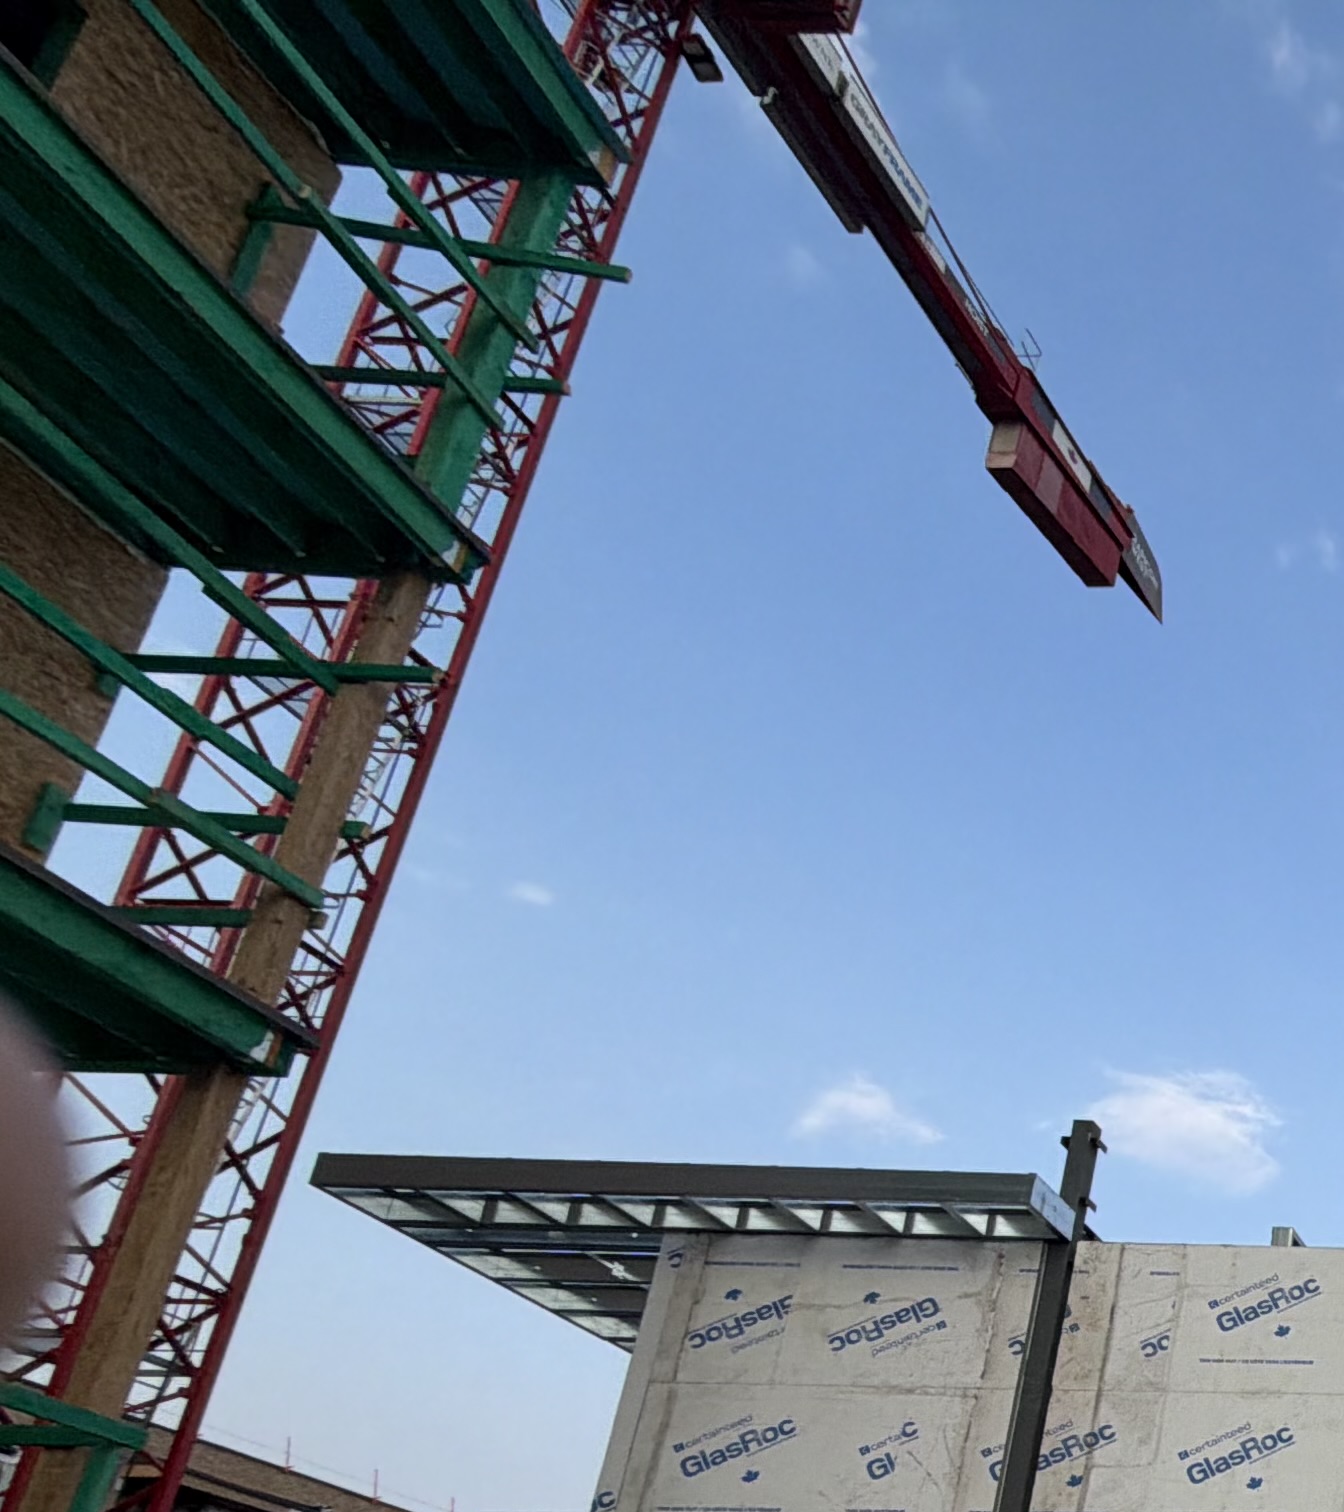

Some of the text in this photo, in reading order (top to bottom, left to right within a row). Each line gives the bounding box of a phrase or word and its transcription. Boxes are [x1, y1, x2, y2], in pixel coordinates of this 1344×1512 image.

[828, 1297, 940, 1353] GlasRoc
[1216, 1277, 1320, 1333] GlasRoc
[680, 1418, 797, 1478] GlasRoc
[1186, 1427, 1296, 1485] GlasRoc
